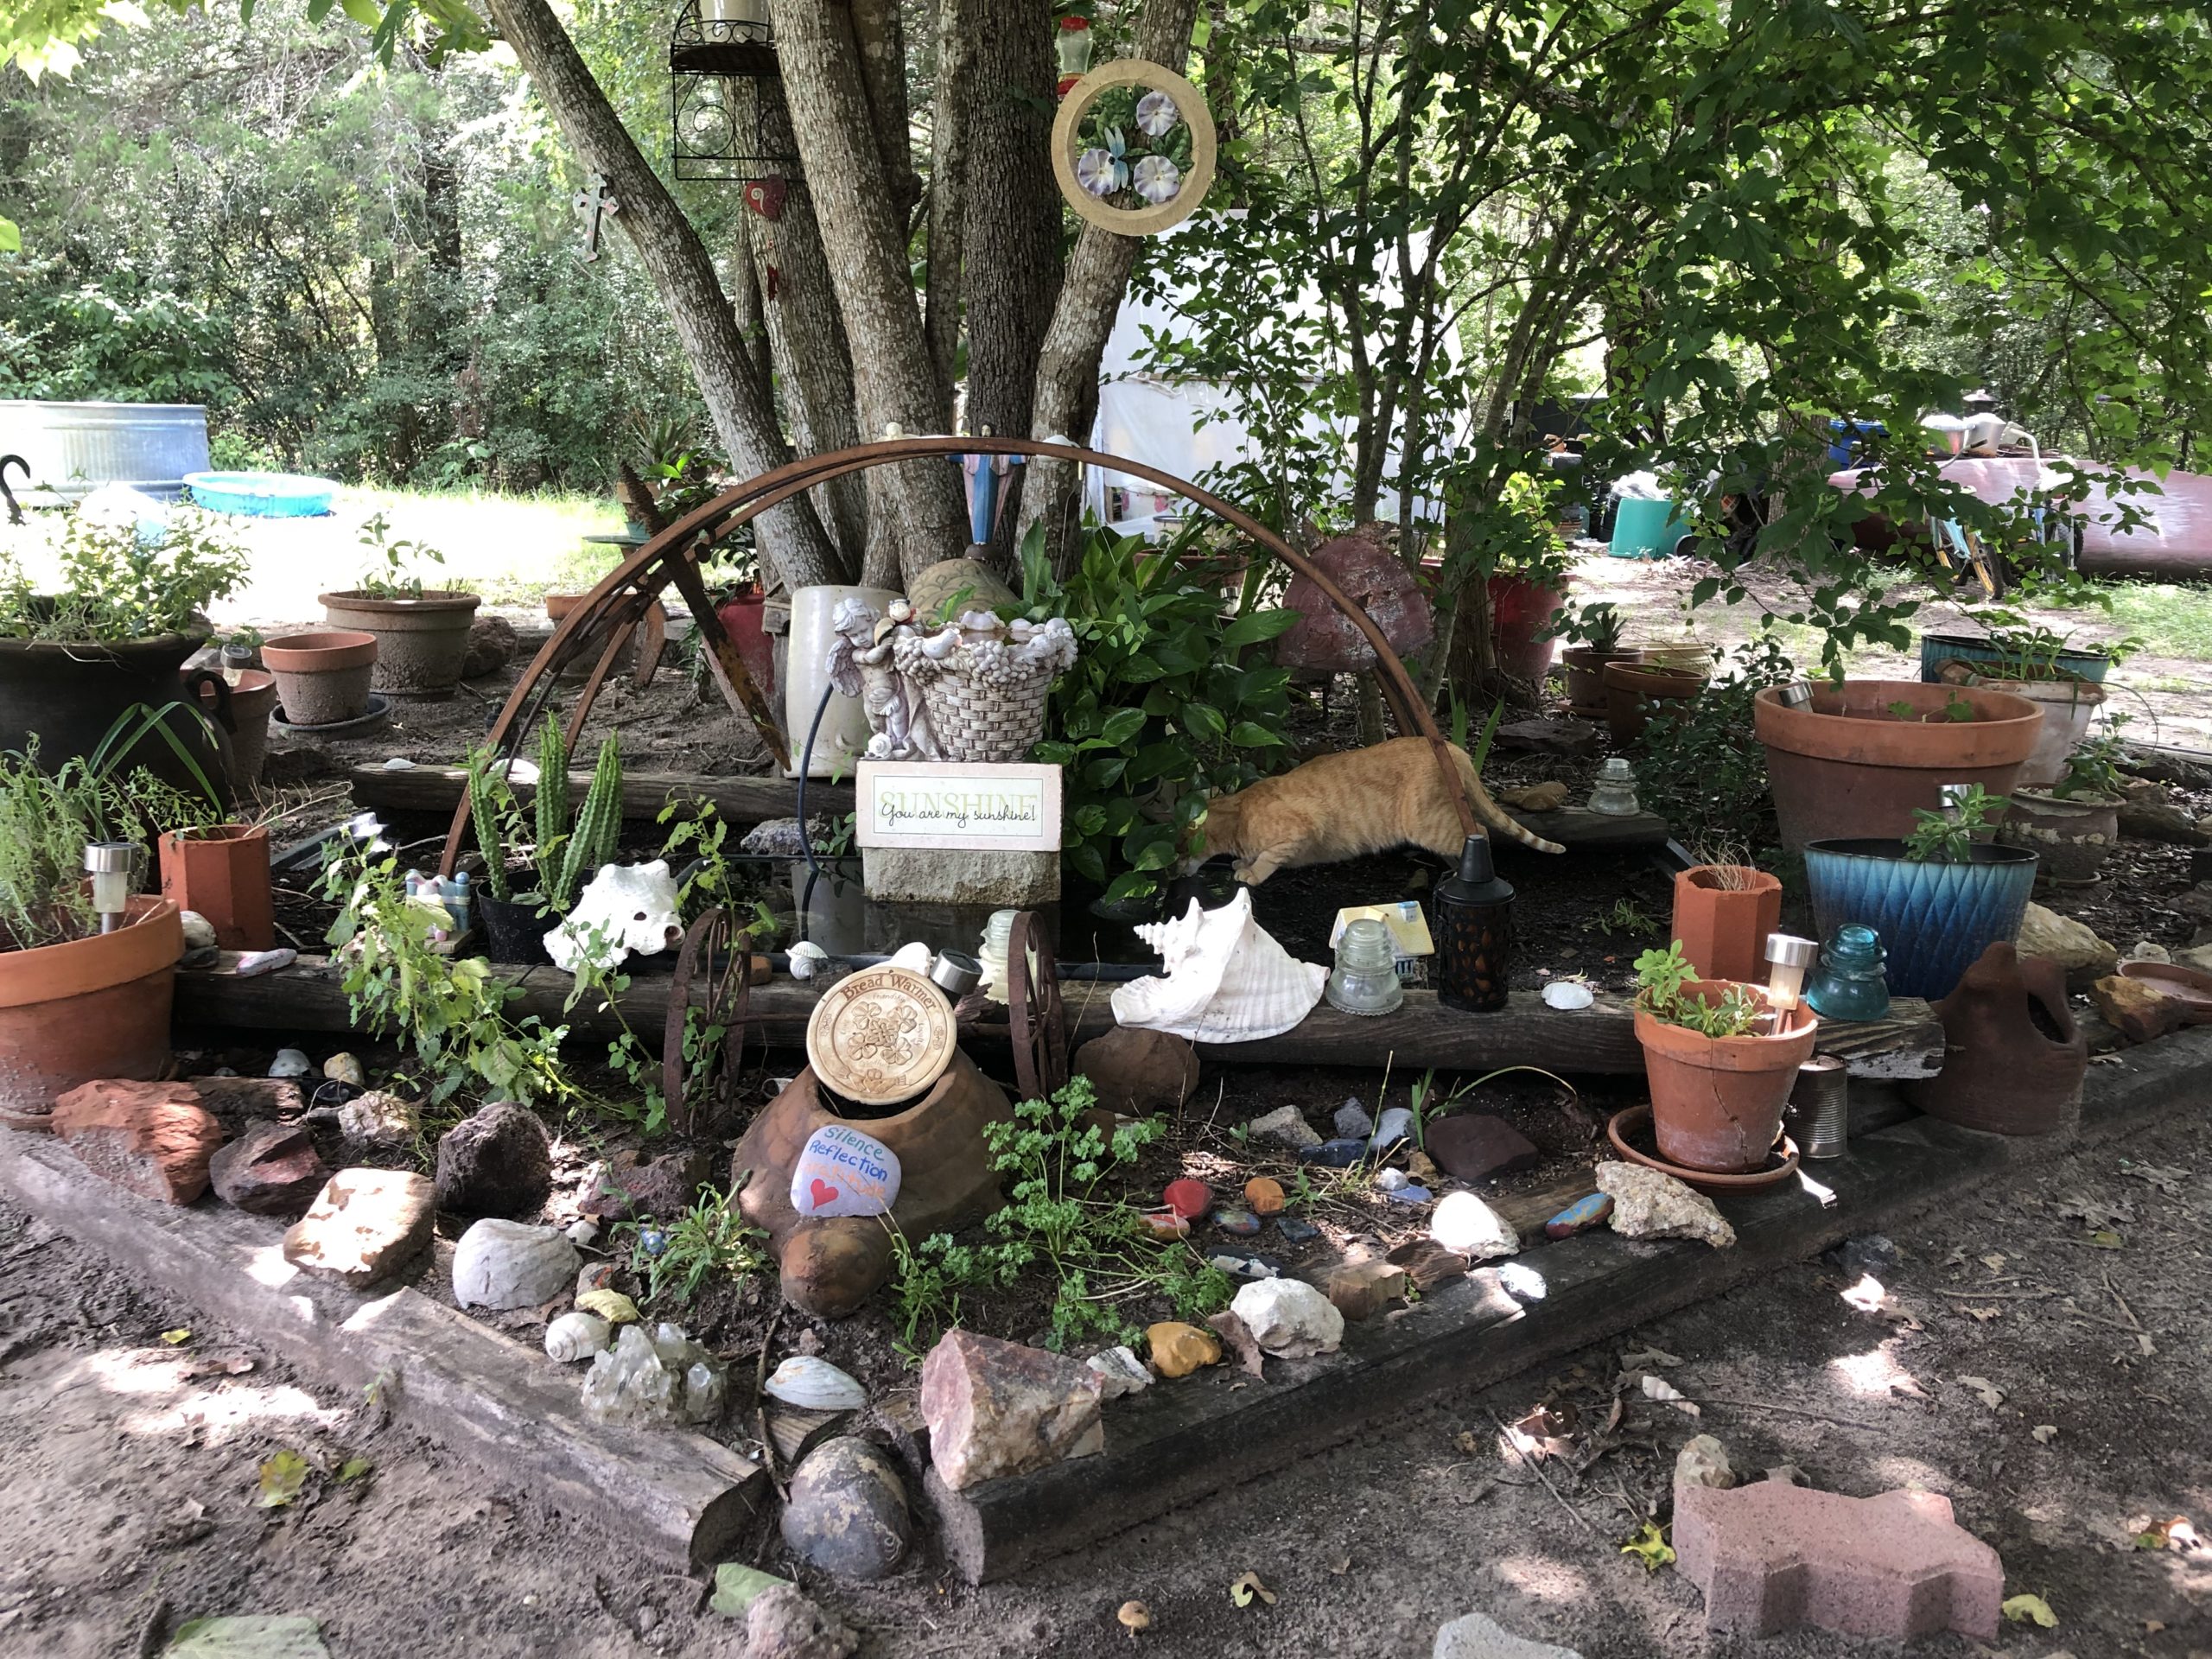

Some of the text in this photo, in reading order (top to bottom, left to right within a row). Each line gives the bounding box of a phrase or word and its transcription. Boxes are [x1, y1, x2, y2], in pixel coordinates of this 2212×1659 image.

[879, 791, 1038, 819] SUNSHINE
[881, 803, 1036, 828] You are my sunshine!
[839, 975, 937, 1010] Bread Warmer
[809, 1139, 888, 1183] Reflection
[824, 1127, 885, 1161] Silence
